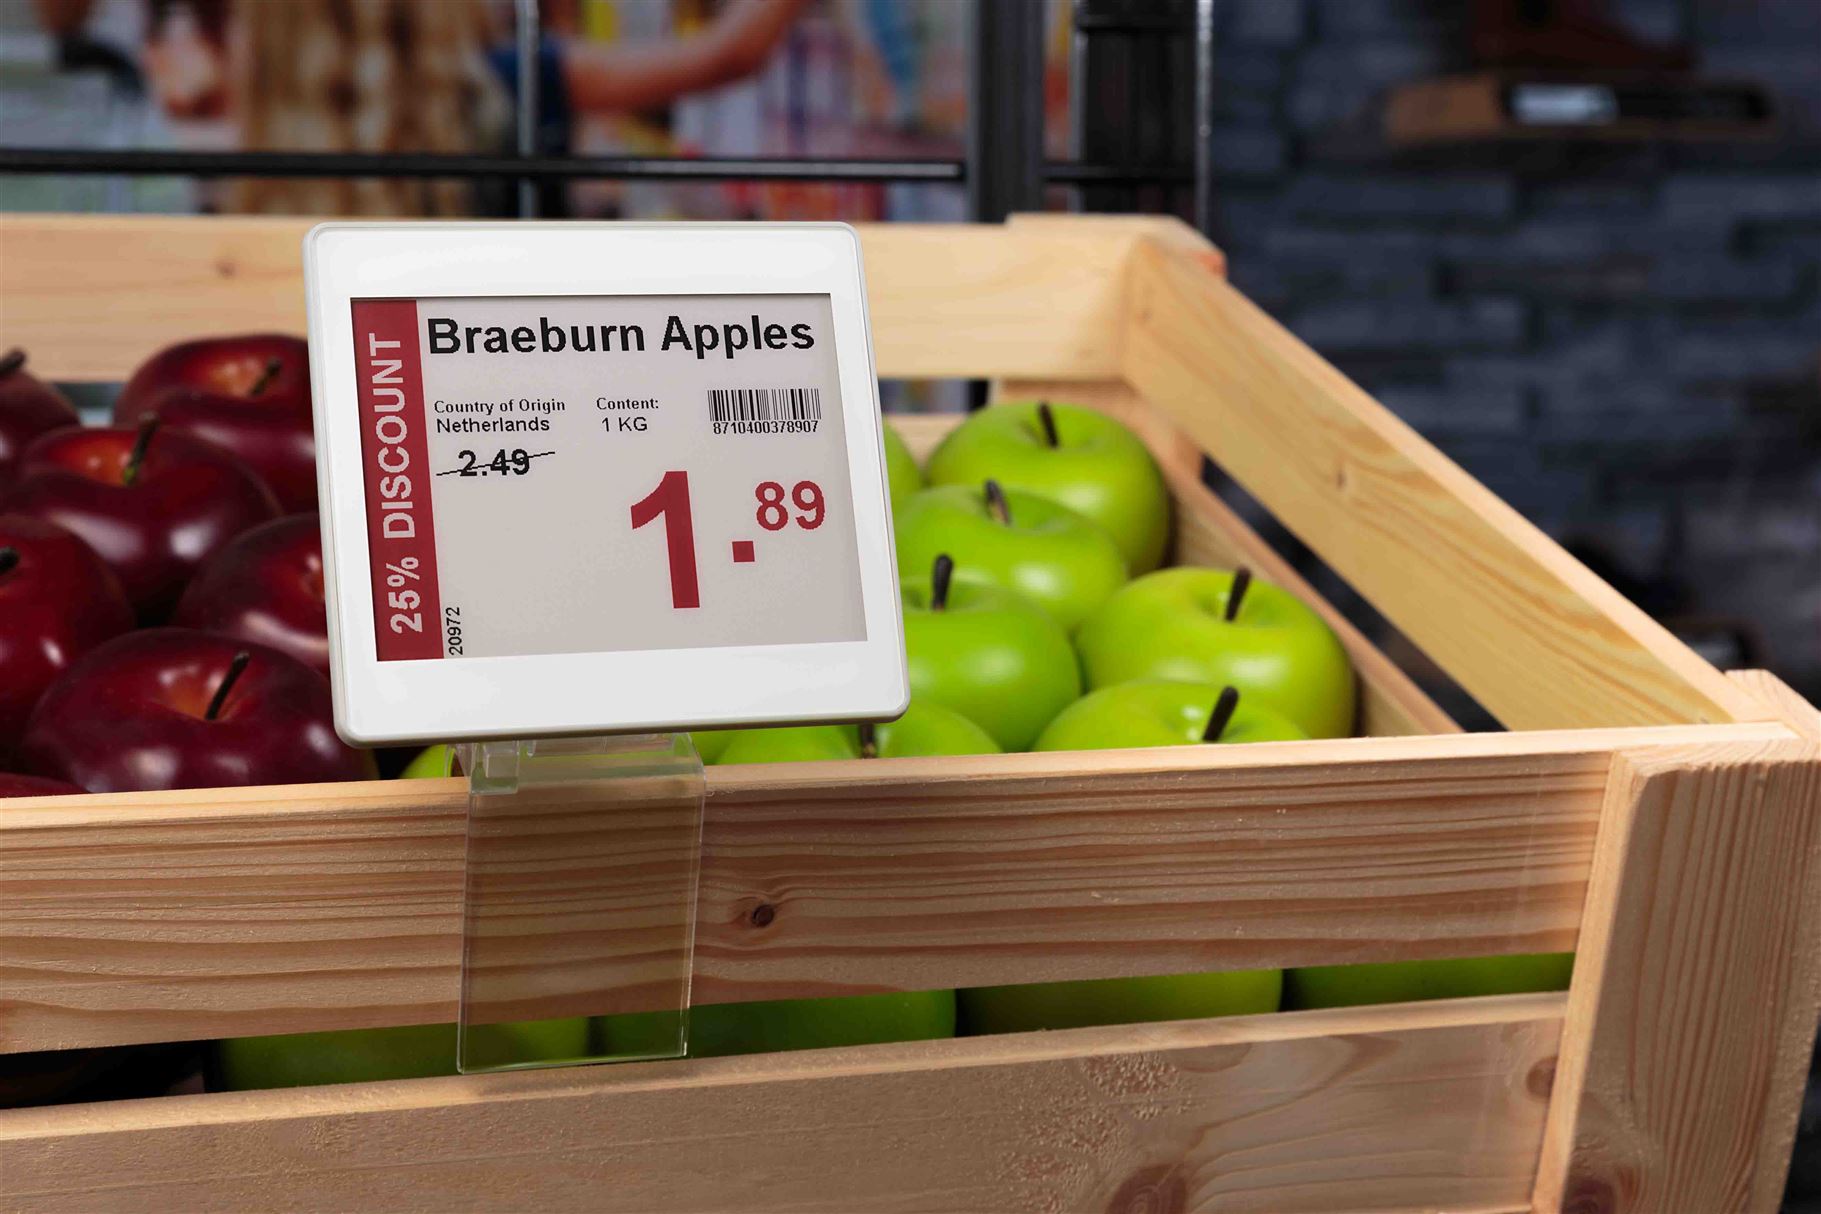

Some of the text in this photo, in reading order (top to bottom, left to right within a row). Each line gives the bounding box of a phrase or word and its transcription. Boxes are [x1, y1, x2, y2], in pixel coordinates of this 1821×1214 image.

[428, 315, 815, 360] Braeburn Apples
[434, 399, 566, 416] Country of Origin
[596, 397, 659, 411] Content:
[436, 417, 550, 433] Netherlands
[601, 416, 648, 432] 1 KG
[712, 420, 819, 434] 8710400378907
[458, 449, 530, 476] 2.49
[369, 332, 422, 634] 25% DISCOUNT
[446, 606, 463, 655] 20972
